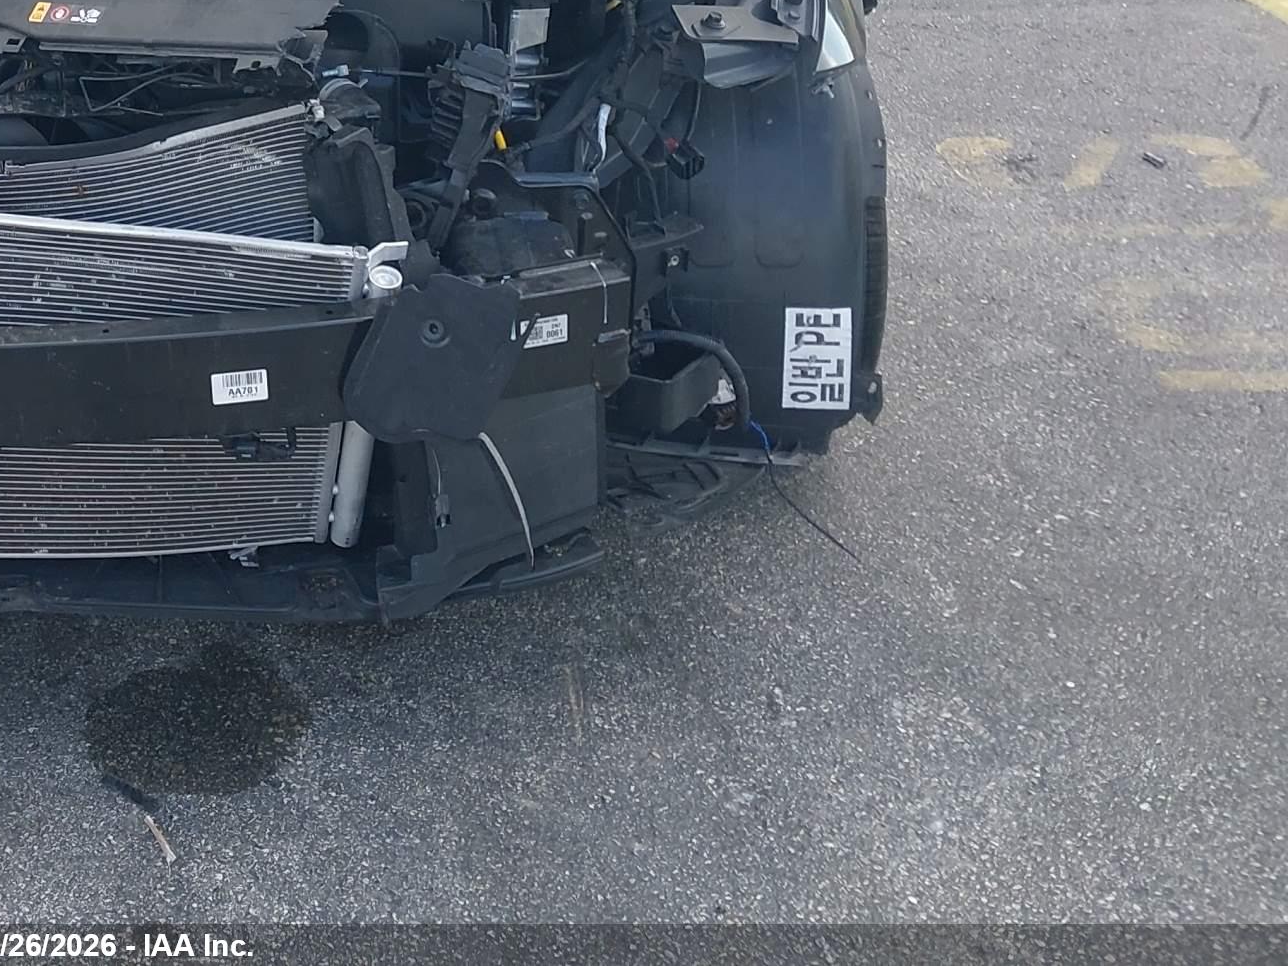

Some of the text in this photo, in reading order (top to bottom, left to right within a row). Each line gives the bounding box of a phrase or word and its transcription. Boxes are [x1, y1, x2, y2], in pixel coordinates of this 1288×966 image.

[788, 312, 845, 404] 일반 PE
[228, 385, 259, 396] AA701
